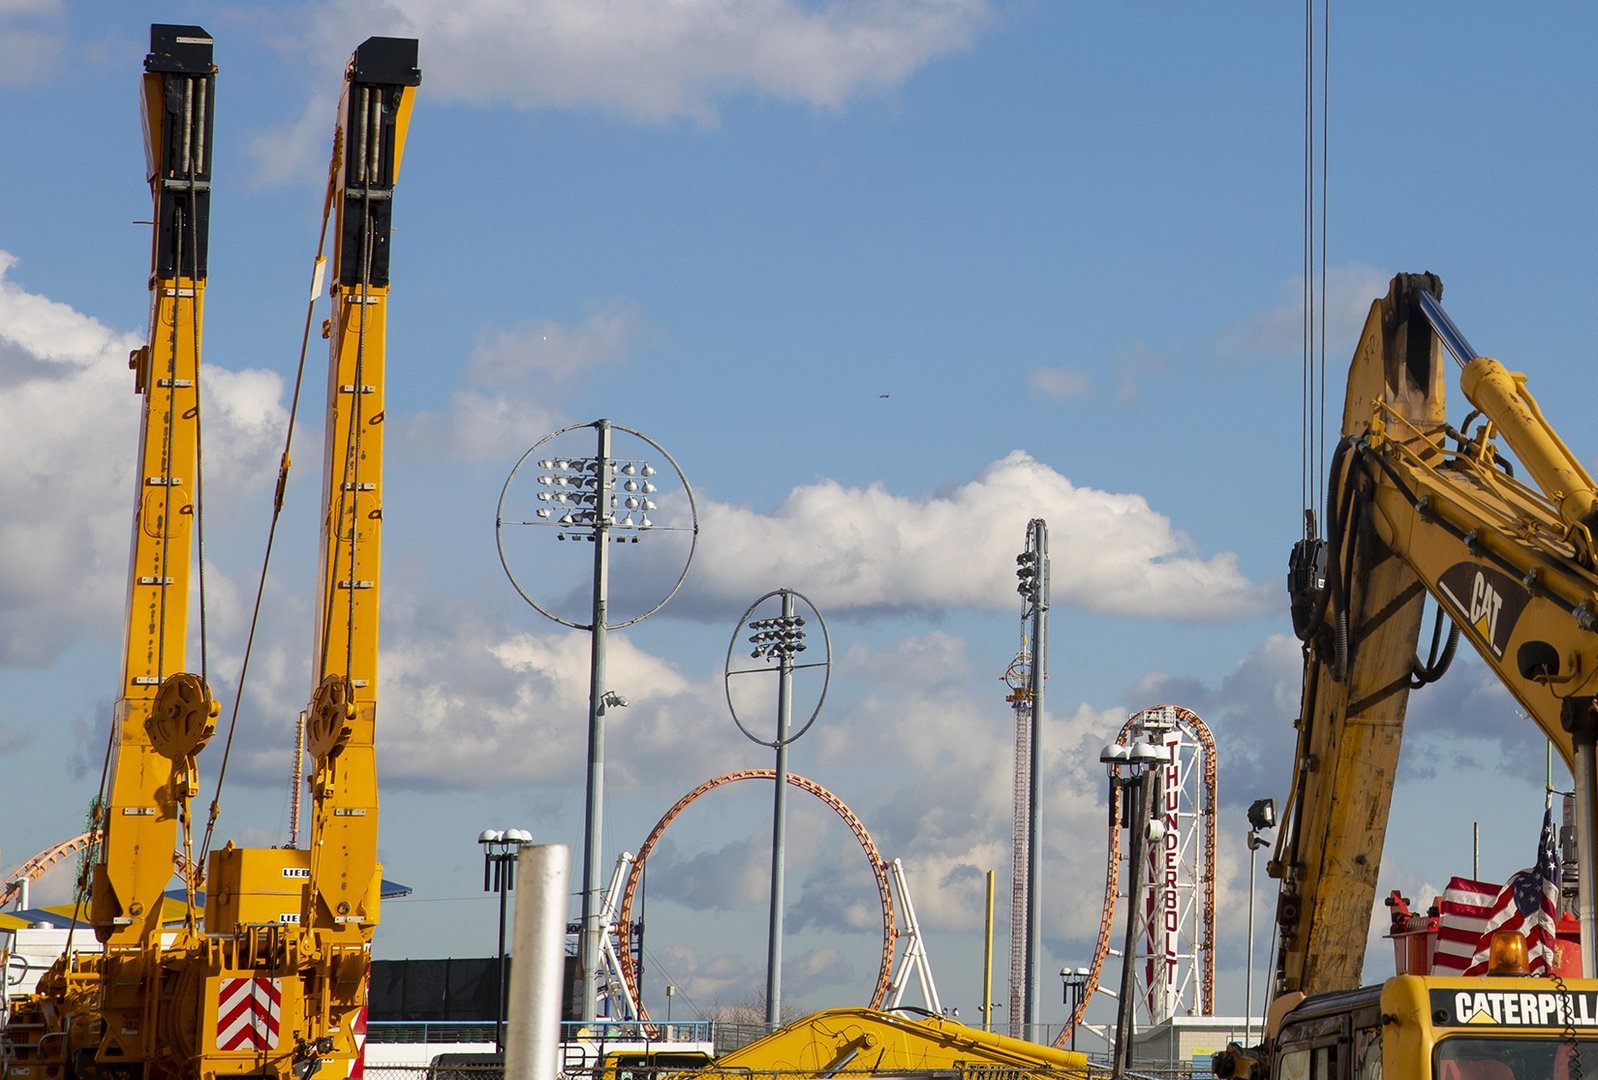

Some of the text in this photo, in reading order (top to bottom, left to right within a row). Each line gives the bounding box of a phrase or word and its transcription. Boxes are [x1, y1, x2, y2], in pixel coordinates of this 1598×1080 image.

[1470, 571, 1503, 647] CAT
[1165, 740, 1178, 985] THUNDERBOLT
[280, 914, 301, 923] LIE
